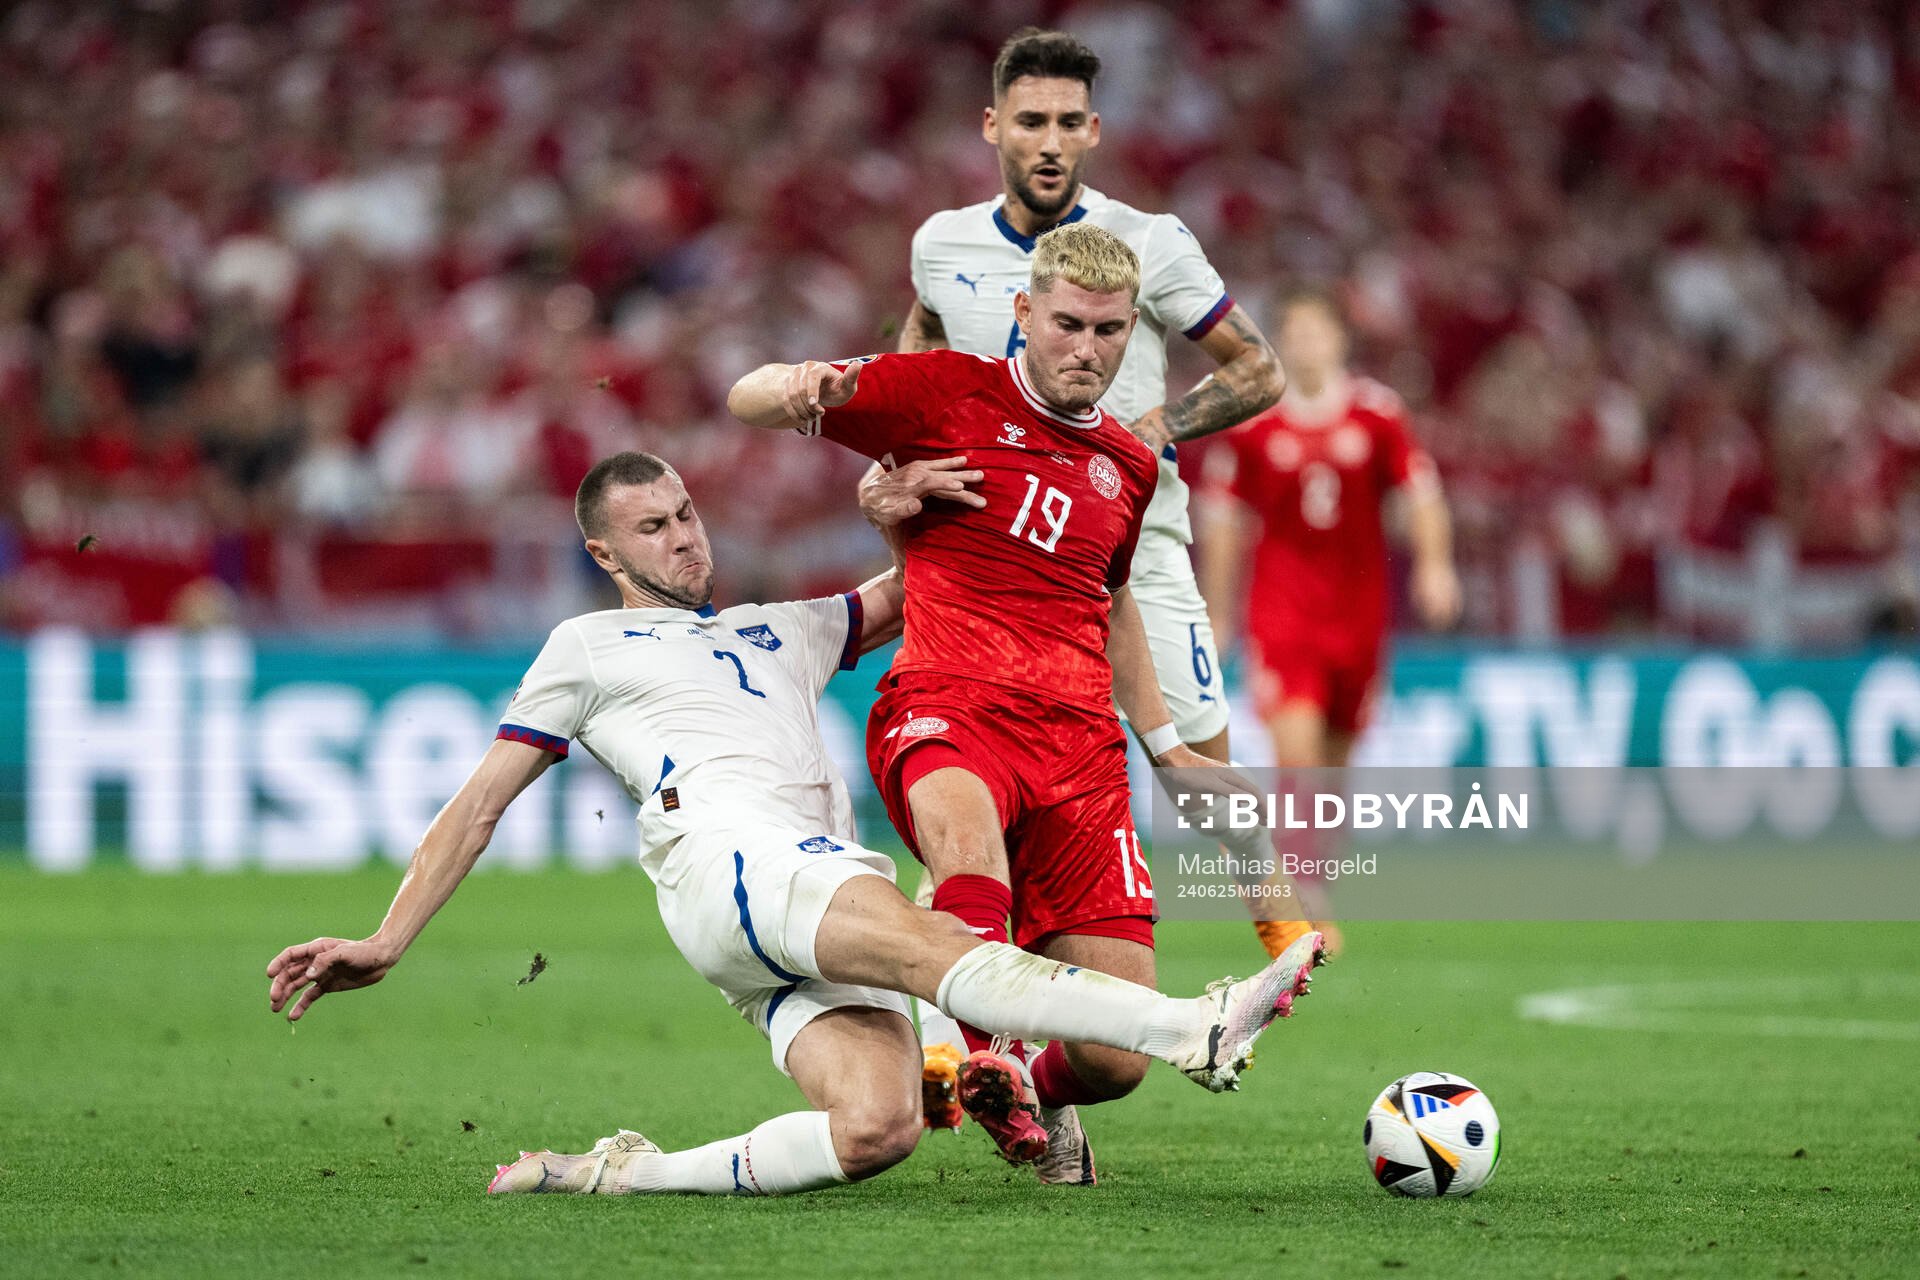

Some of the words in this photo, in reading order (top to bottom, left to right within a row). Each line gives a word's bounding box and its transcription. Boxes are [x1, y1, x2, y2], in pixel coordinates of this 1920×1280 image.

[1009, 473, 1073, 553] 19
[712, 649, 766, 698] 2
[1190, 623, 1212, 687] 6
